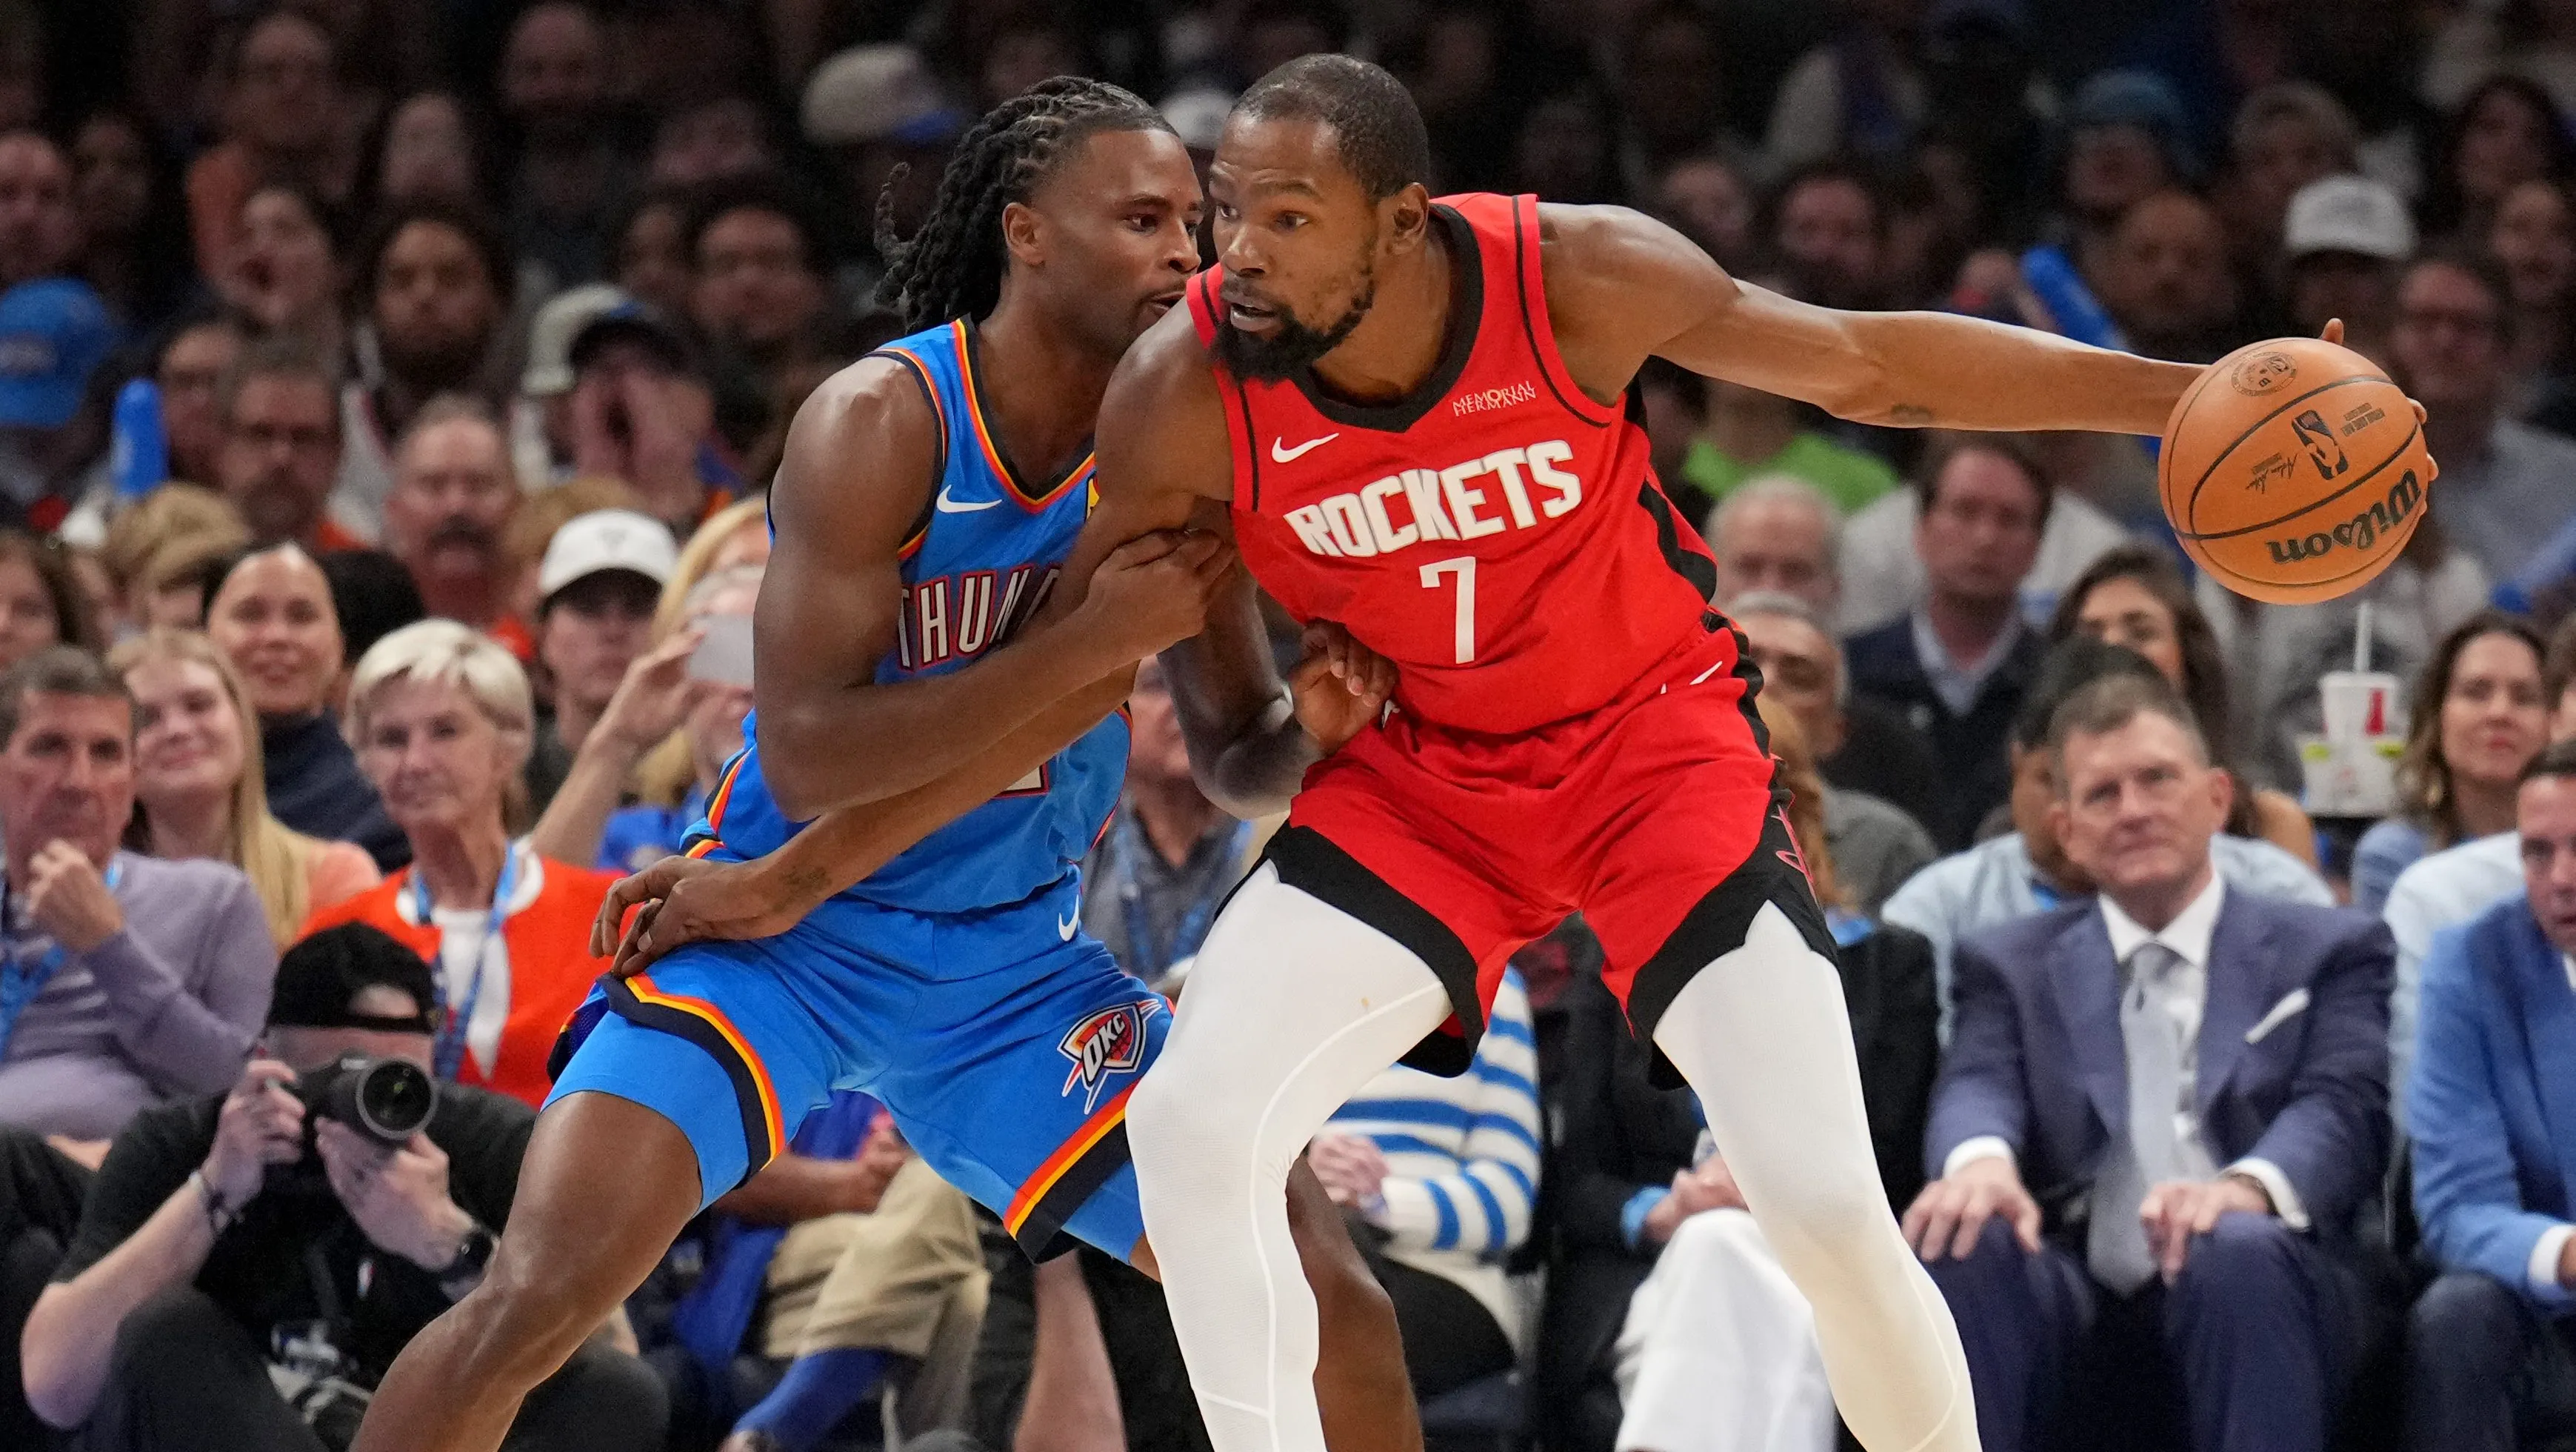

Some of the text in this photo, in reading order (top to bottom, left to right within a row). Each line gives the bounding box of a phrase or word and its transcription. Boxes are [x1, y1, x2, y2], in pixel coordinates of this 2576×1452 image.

[1452, 380, 1535, 407] MEMORIAL
[1453, 387, 1536, 416] HERMANN
[1284, 440, 1583, 557] ROCKETS
[2264, 468, 2422, 565] Wilson
[1419, 556, 1476, 665] 7
[1083, 1013, 1125, 1082] OKC
